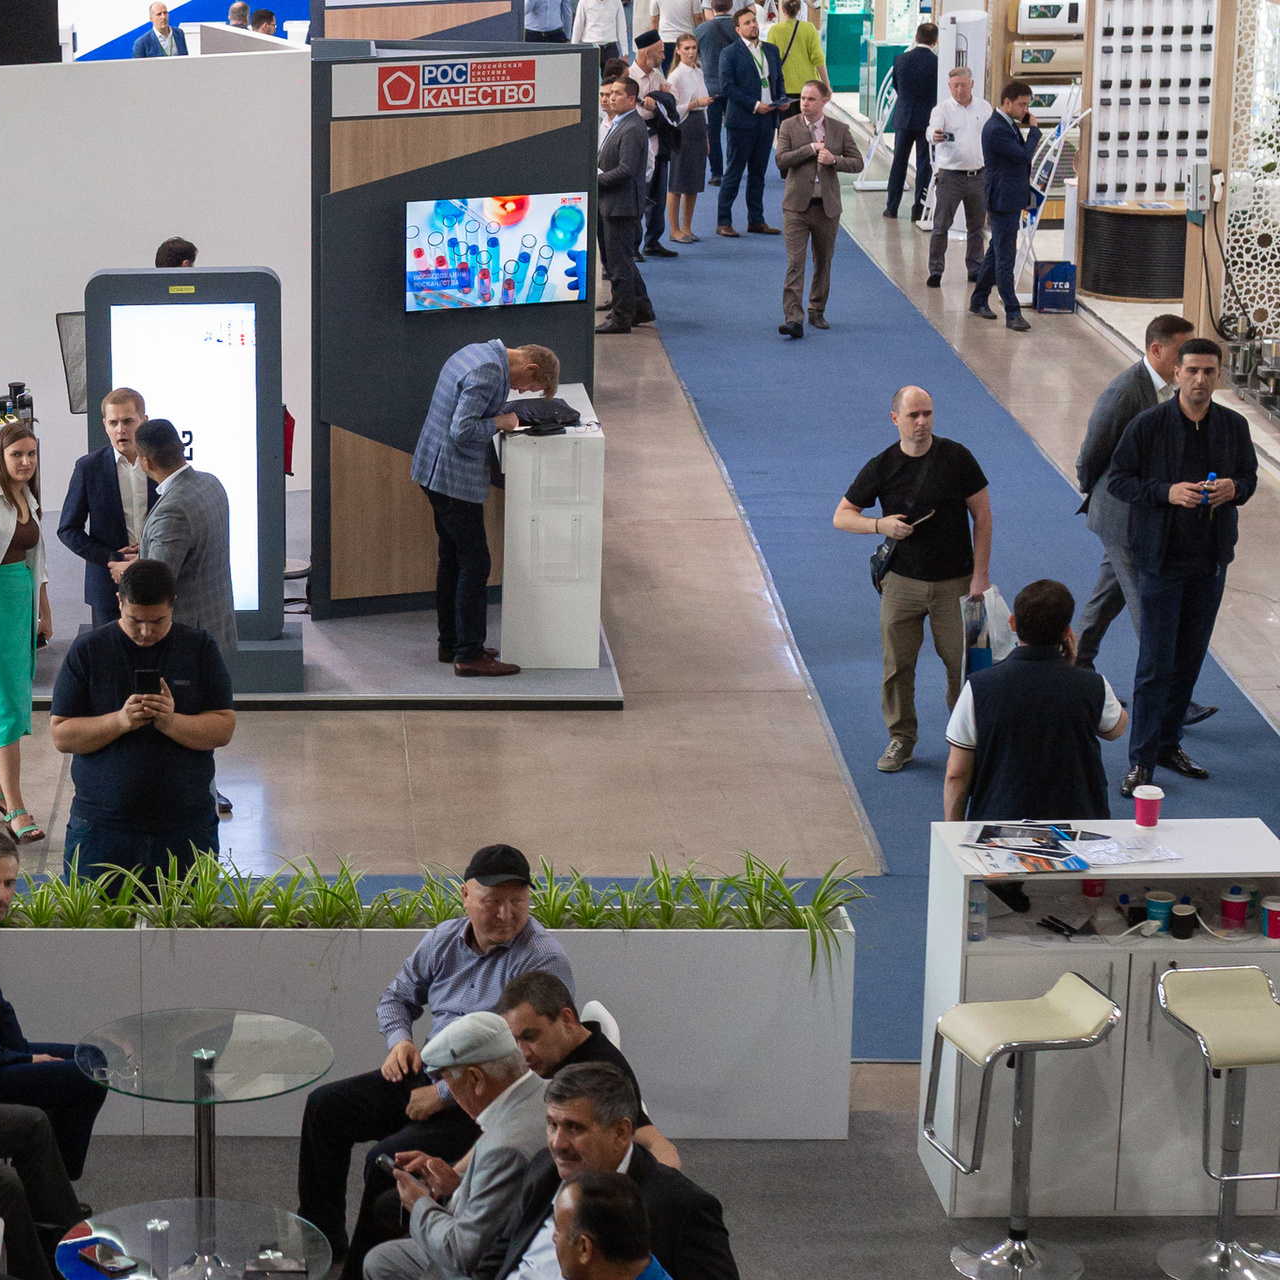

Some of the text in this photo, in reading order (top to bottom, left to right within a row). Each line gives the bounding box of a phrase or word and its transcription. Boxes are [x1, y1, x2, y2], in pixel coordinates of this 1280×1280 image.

[424, 64, 467, 84] РОС
[471, 62, 523, 70] Российская
[423, 84, 534, 107] КАЧЕСТВО
